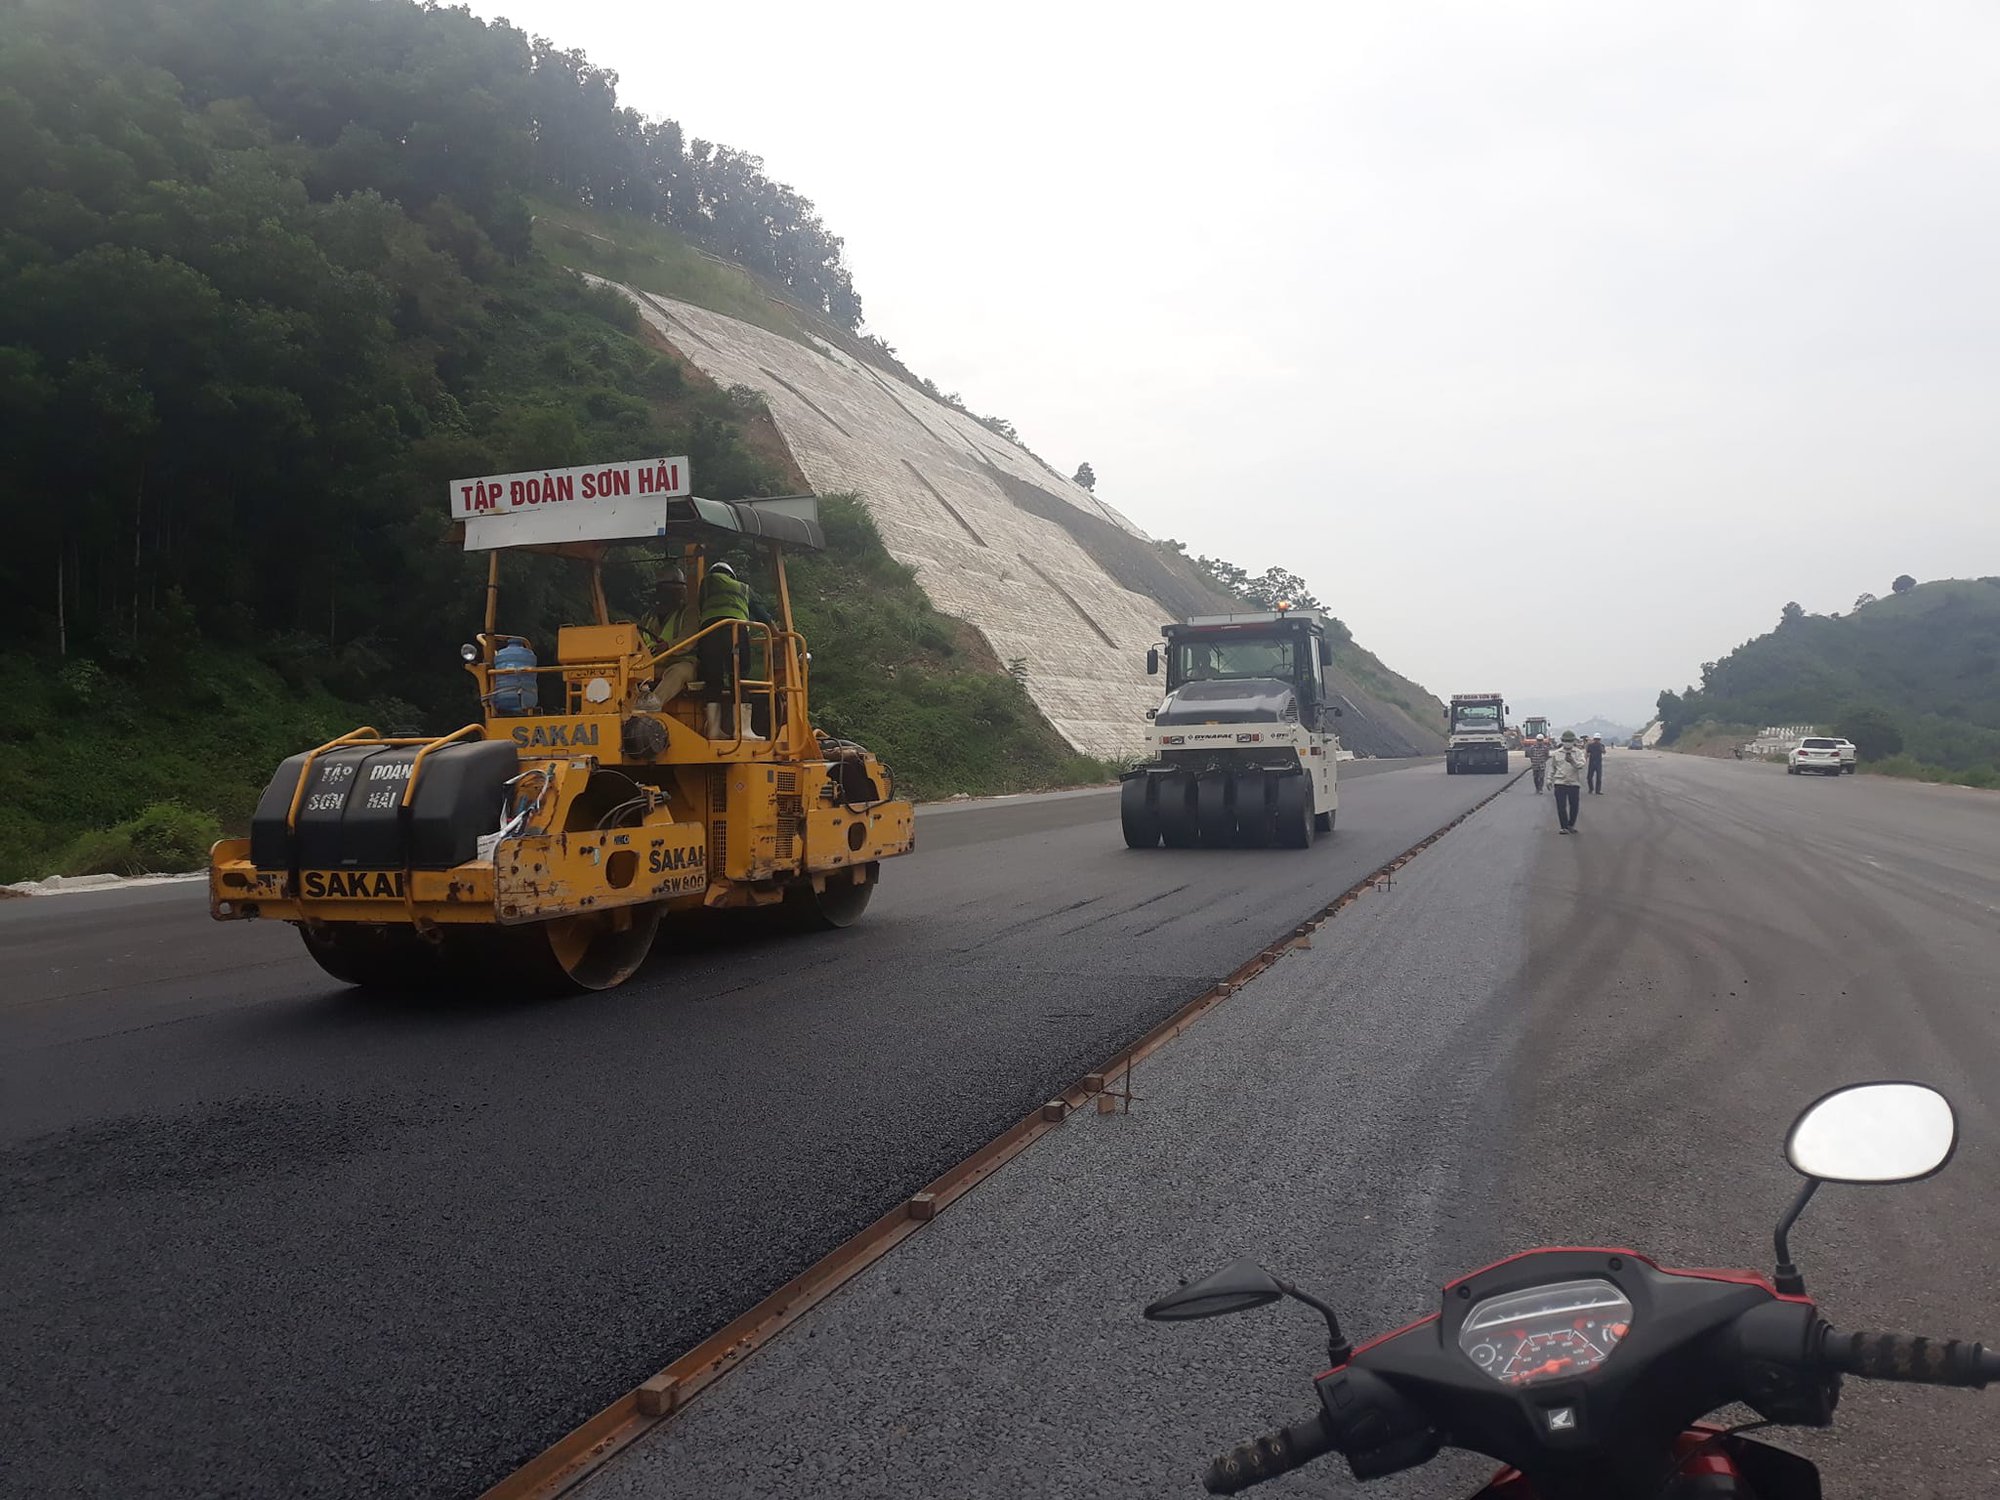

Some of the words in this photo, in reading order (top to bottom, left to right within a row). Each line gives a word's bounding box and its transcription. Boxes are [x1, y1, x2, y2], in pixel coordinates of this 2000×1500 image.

[460, 480, 502, 513] TẬP
[510, 473, 574, 506] ĐOÀN
[581, 468, 630, 499] SƠN
[638, 459, 679, 493] HẢI
[512, 723, 599, 748] SAKAI
[648, 845, 704, 873] SAKAI
[305, 871, 404, 897] SAKAI
